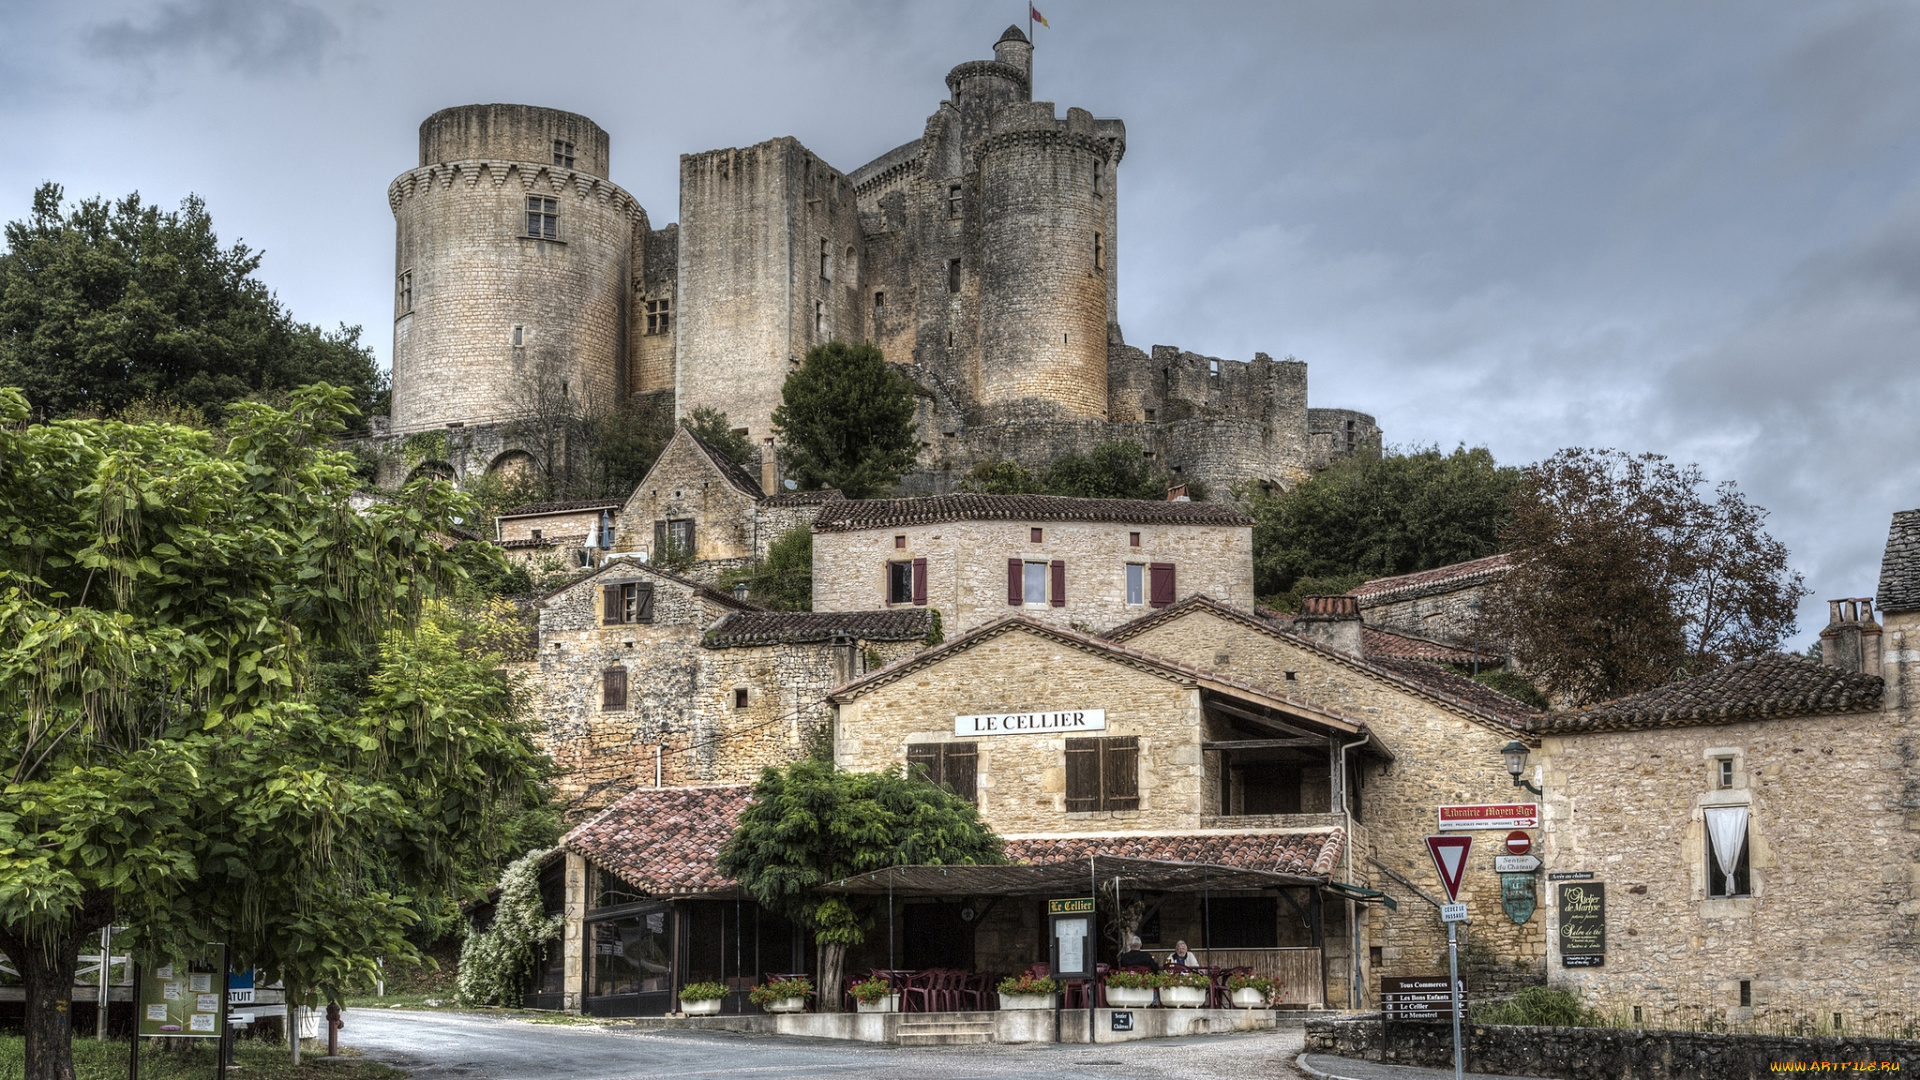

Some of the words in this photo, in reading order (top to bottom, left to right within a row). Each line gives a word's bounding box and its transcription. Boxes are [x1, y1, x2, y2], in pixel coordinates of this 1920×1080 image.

[974, 717, 998, 731] LE
[1003, 712, 1086, 730] CELLIER
[1443, 807, 1481, 818] Librairie
[1484, 806, 1514, 818] Moyen
[1051, 901, 1062, 912] Le
[1064, 900, 1092, 911] Cellier
[1564, 903, 1574, 912] de
[1561, 923, 1584, 938] Salon
[1585, 925, 1594, 935] de
[228, 991, 252, 1001] ATUIT
